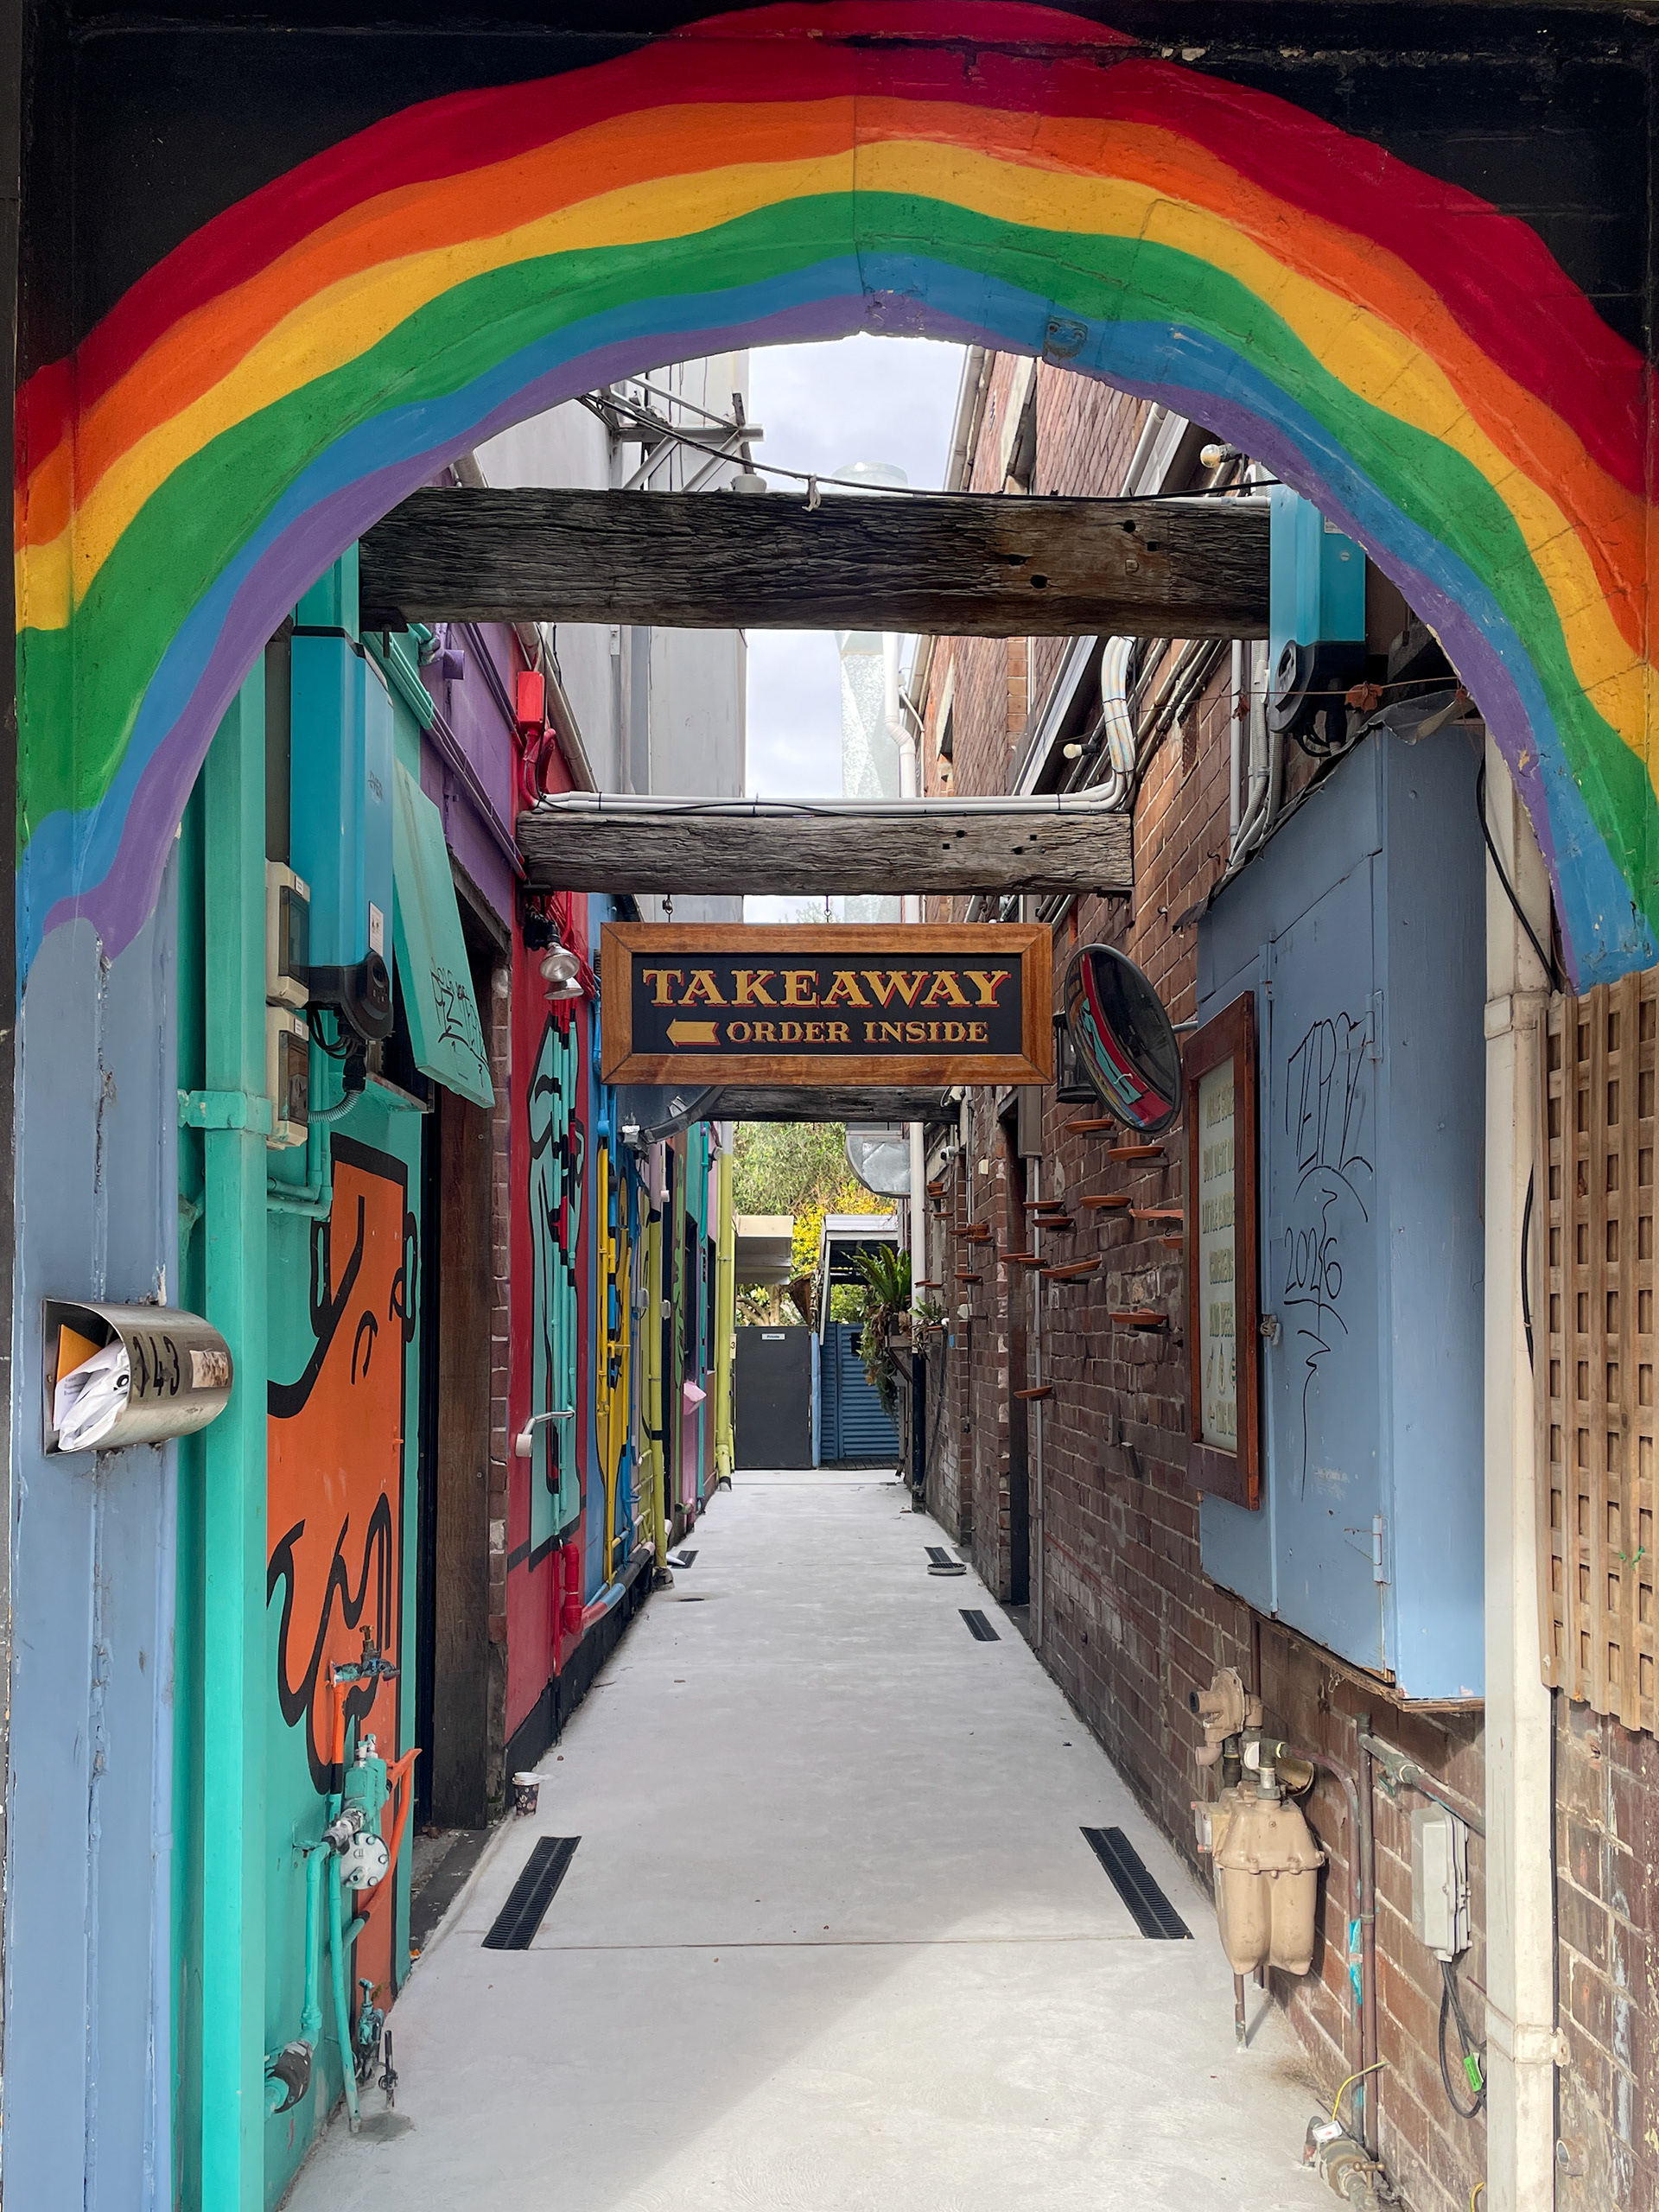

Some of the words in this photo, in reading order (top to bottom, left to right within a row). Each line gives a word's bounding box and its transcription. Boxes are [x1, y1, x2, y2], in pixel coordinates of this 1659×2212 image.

[642, 969, 1011, 1008] TAKEAWAY
[726, 1020, 852, 1044] ORDER
[863, 1020, 989, 1044] INSIDE
[133, 1336, 180, 1397] 143
